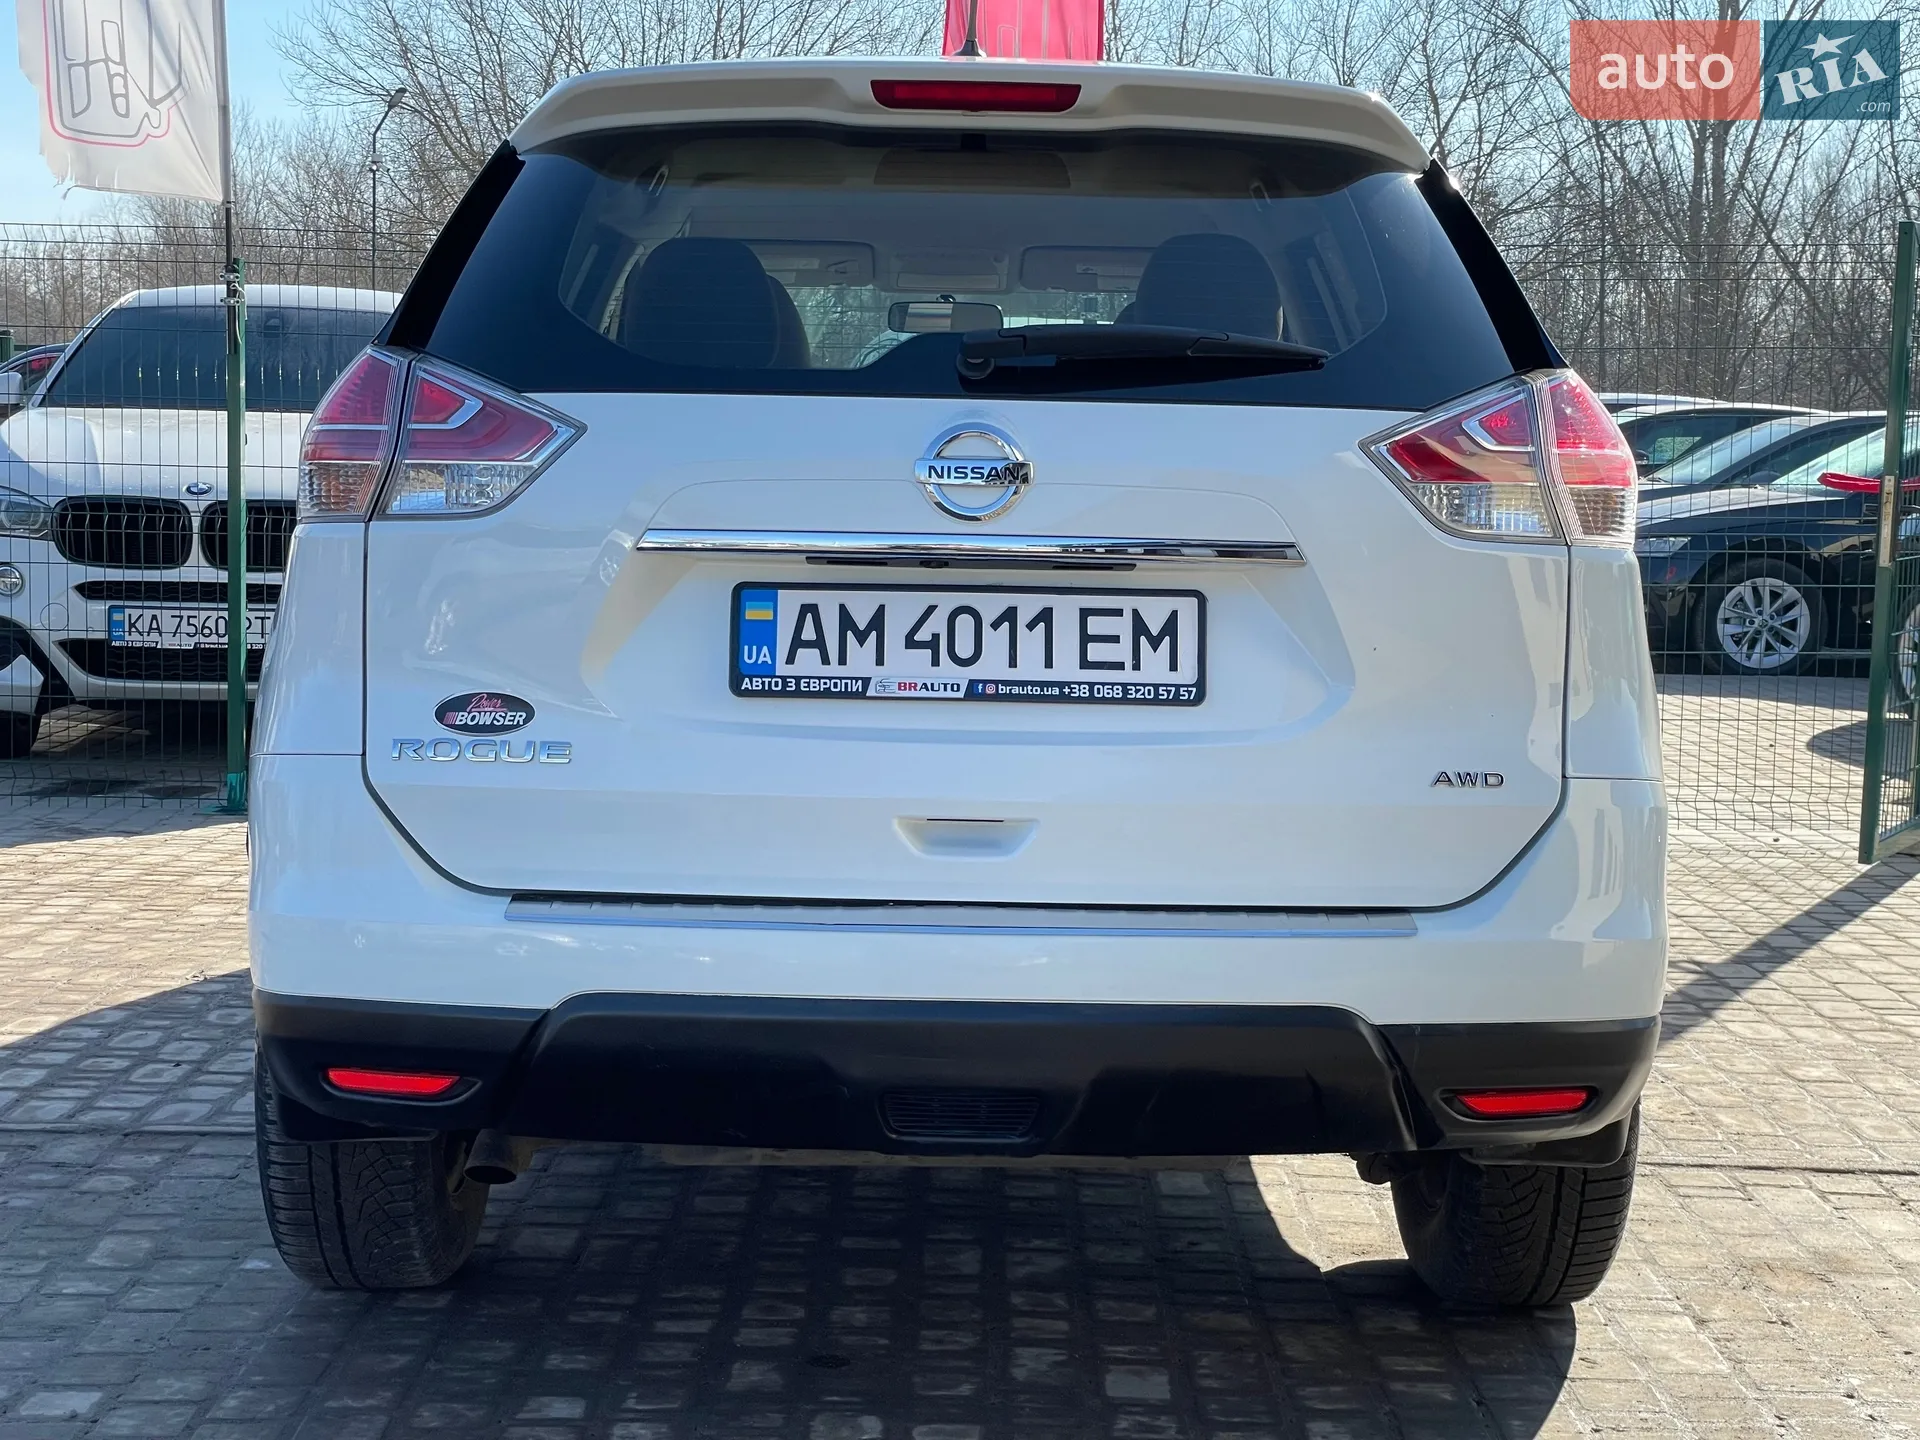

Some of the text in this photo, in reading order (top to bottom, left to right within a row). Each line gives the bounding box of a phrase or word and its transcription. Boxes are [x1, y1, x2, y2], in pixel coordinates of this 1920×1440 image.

[928, 465, 1020, 480] NISSAN
[128, 613, 162, 637] KA
[170, 615, 228, 638] 7560
[785, 603, 1178, 672] AM 4011 EM
[743, 645, 772, 665] UA
[741, 677, 782, 691] АВТО
[800, 679, 863, 692] ЄВРОПИ
[897, 681, 961, 693] BRAUTO
[998, 684, 1196, 700] brauto.ua +38 068 320 57 57
[454, 712, 526, 725] BOWSER
[391, 737, 572, 763] ROGUE
[1430, 771, 1505, 788] AWD
